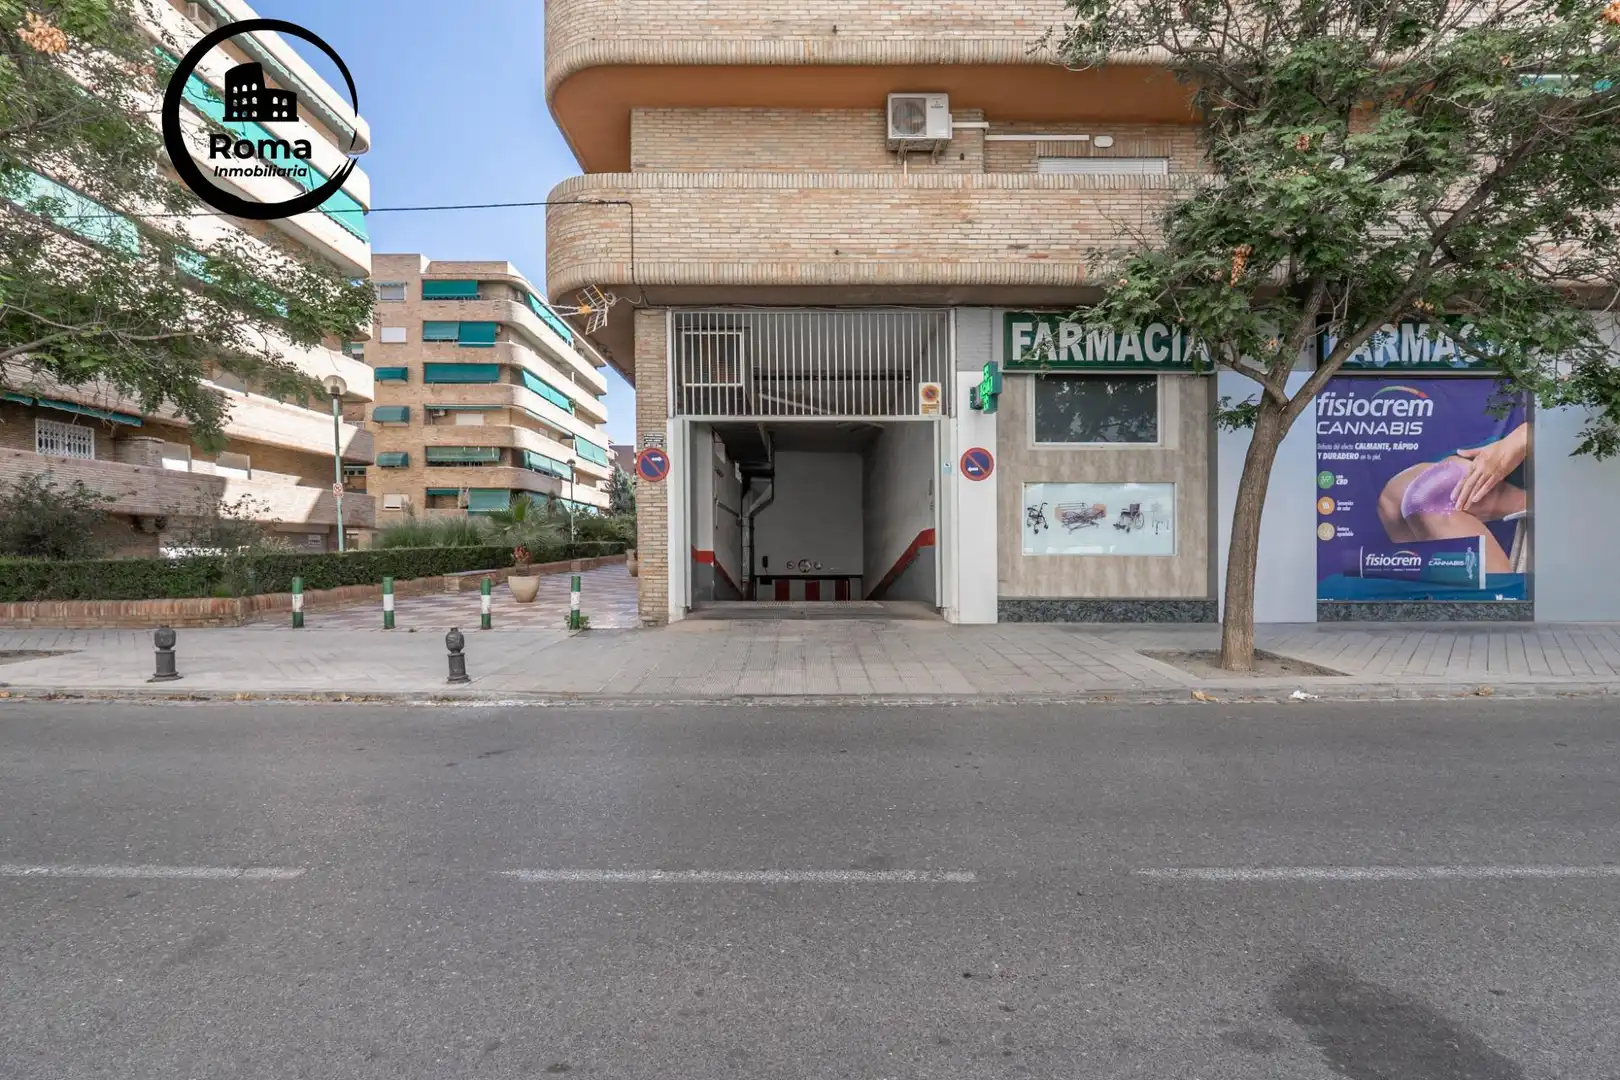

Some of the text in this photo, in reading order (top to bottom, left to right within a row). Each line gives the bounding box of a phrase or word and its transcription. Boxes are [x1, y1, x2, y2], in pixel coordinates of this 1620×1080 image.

[1317, 391, 1434, 417] fisiocrem
[1316, 421, 1424, 435] CANNABIS
[1393, 441, 1419, 450] RÁPIDO
[1317, 452, 1322, 460] Y
[1323, 452, 1360, 460] DURADERO
[1365, 553, 1422, 566] fisiocrem
